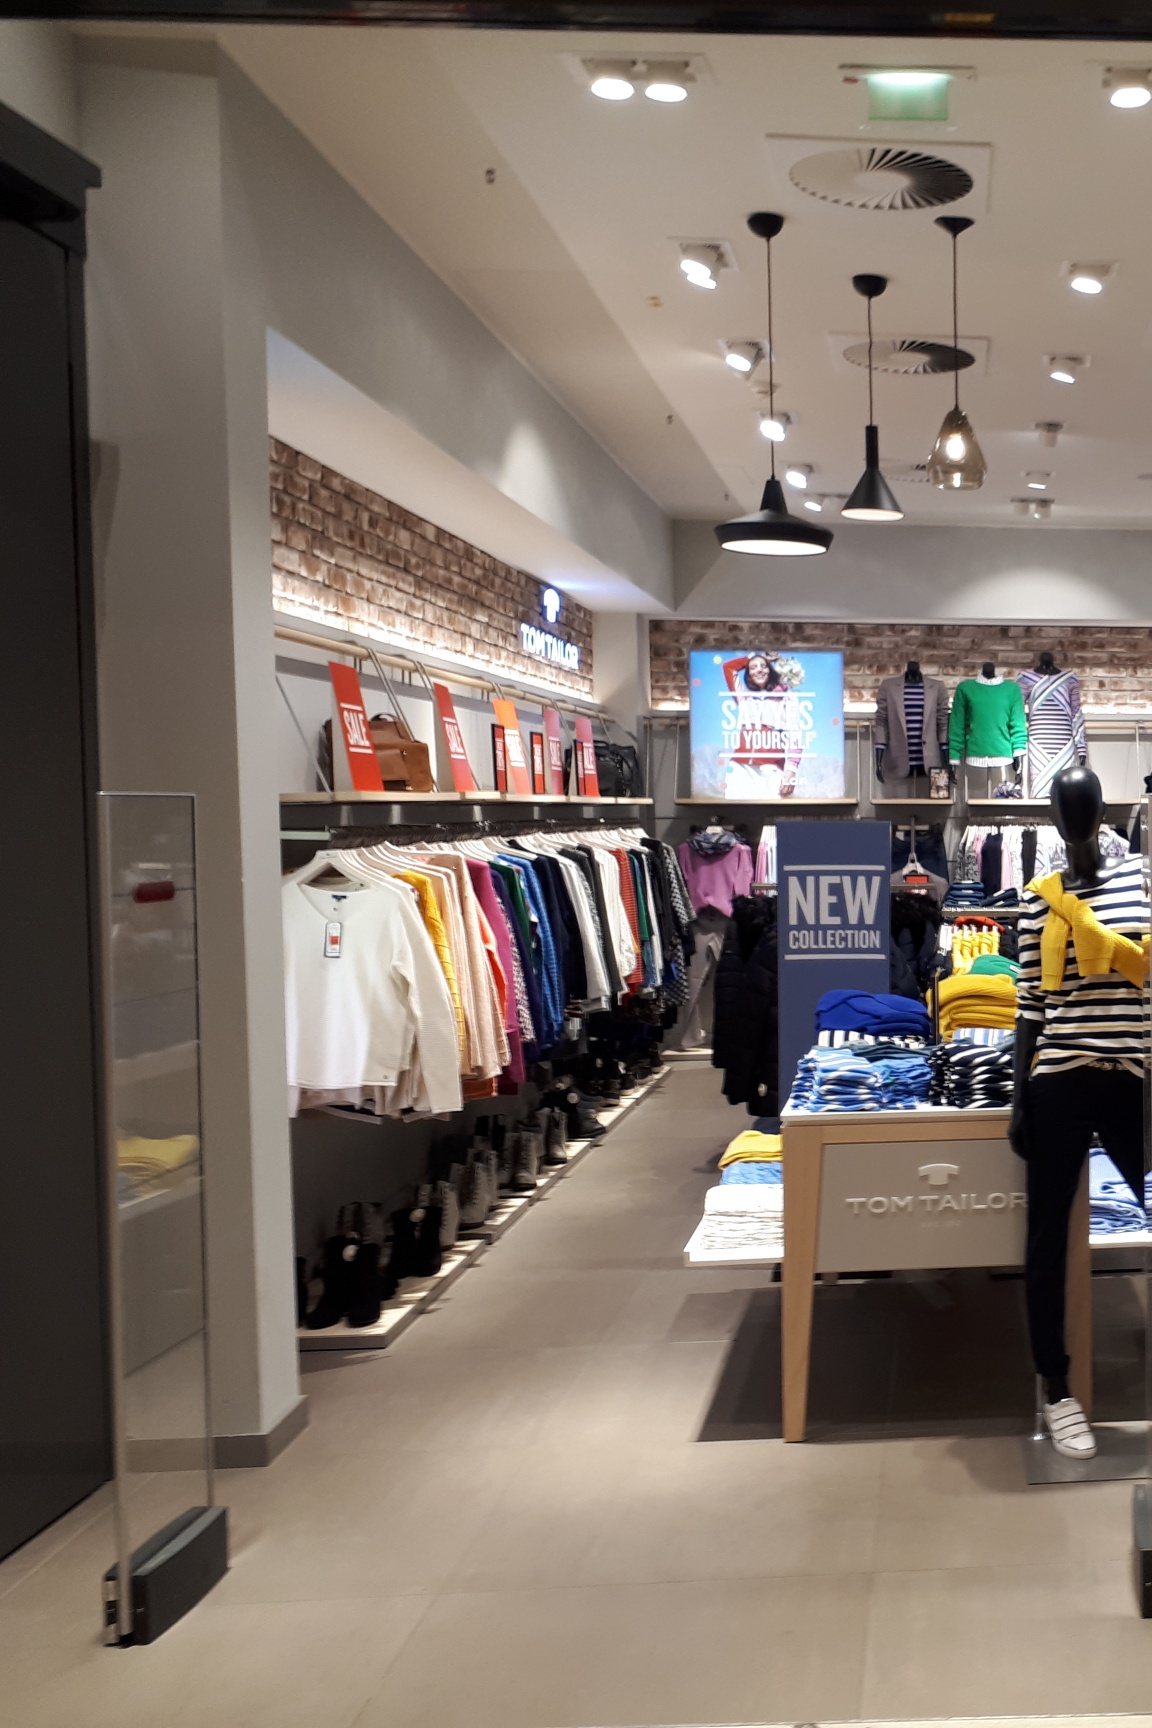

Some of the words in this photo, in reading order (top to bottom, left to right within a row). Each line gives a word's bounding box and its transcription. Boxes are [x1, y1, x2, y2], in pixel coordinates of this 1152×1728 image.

[521, 623, 546, 657] TOM
[546, 634, 579, 669] TAILOR
[343, 710, 371, 747] SALE
[445, 722, 465, 754] SALE
[722, 731, 740, 750] TO
[743, 731, 813, 750] YOURSELF
[788, 875, 881, 925] NEW
[788, 929, 881, 949] COLLECTION
[845, 1195, 914, 1214] TOM
[918, 1192, 1028, 1211] TAILOR
